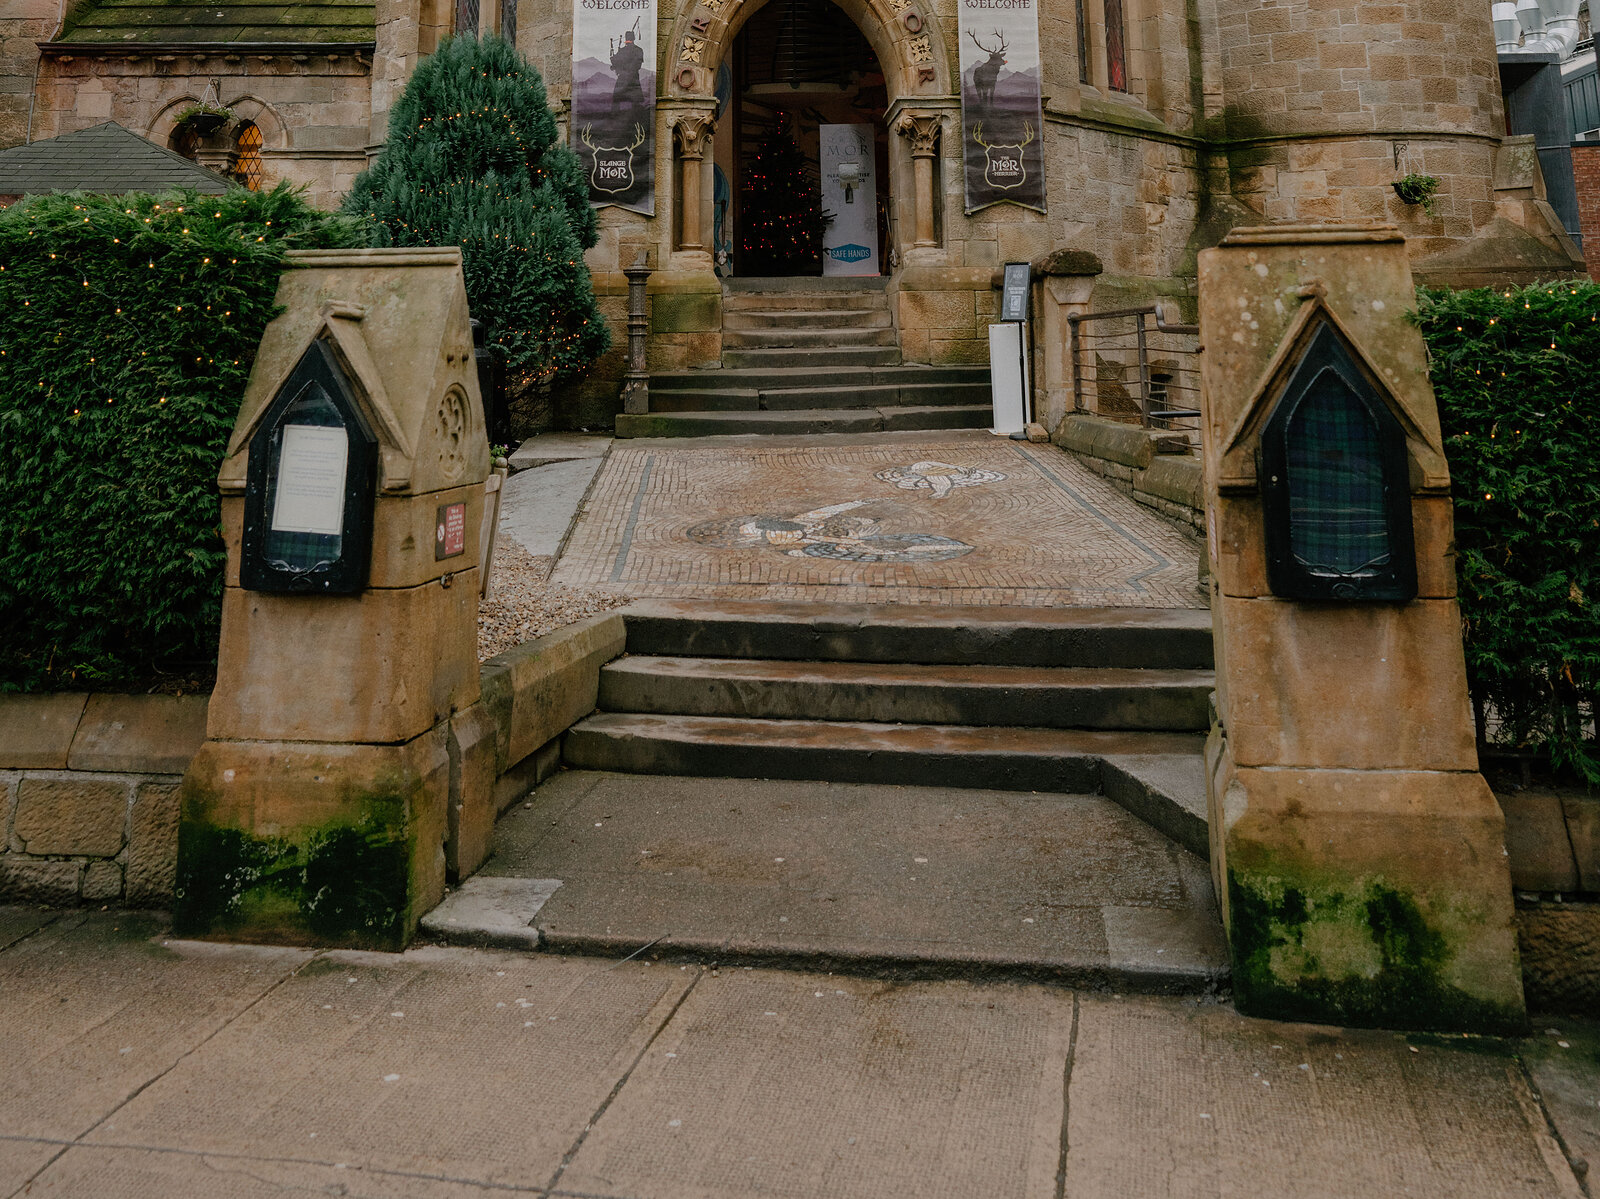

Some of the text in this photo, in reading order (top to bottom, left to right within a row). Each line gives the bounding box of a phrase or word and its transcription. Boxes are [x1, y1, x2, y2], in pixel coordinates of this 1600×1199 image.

[581, 0, 650, 10] WELCOME
[832, 249, 870, 258] SAFE HANDS
